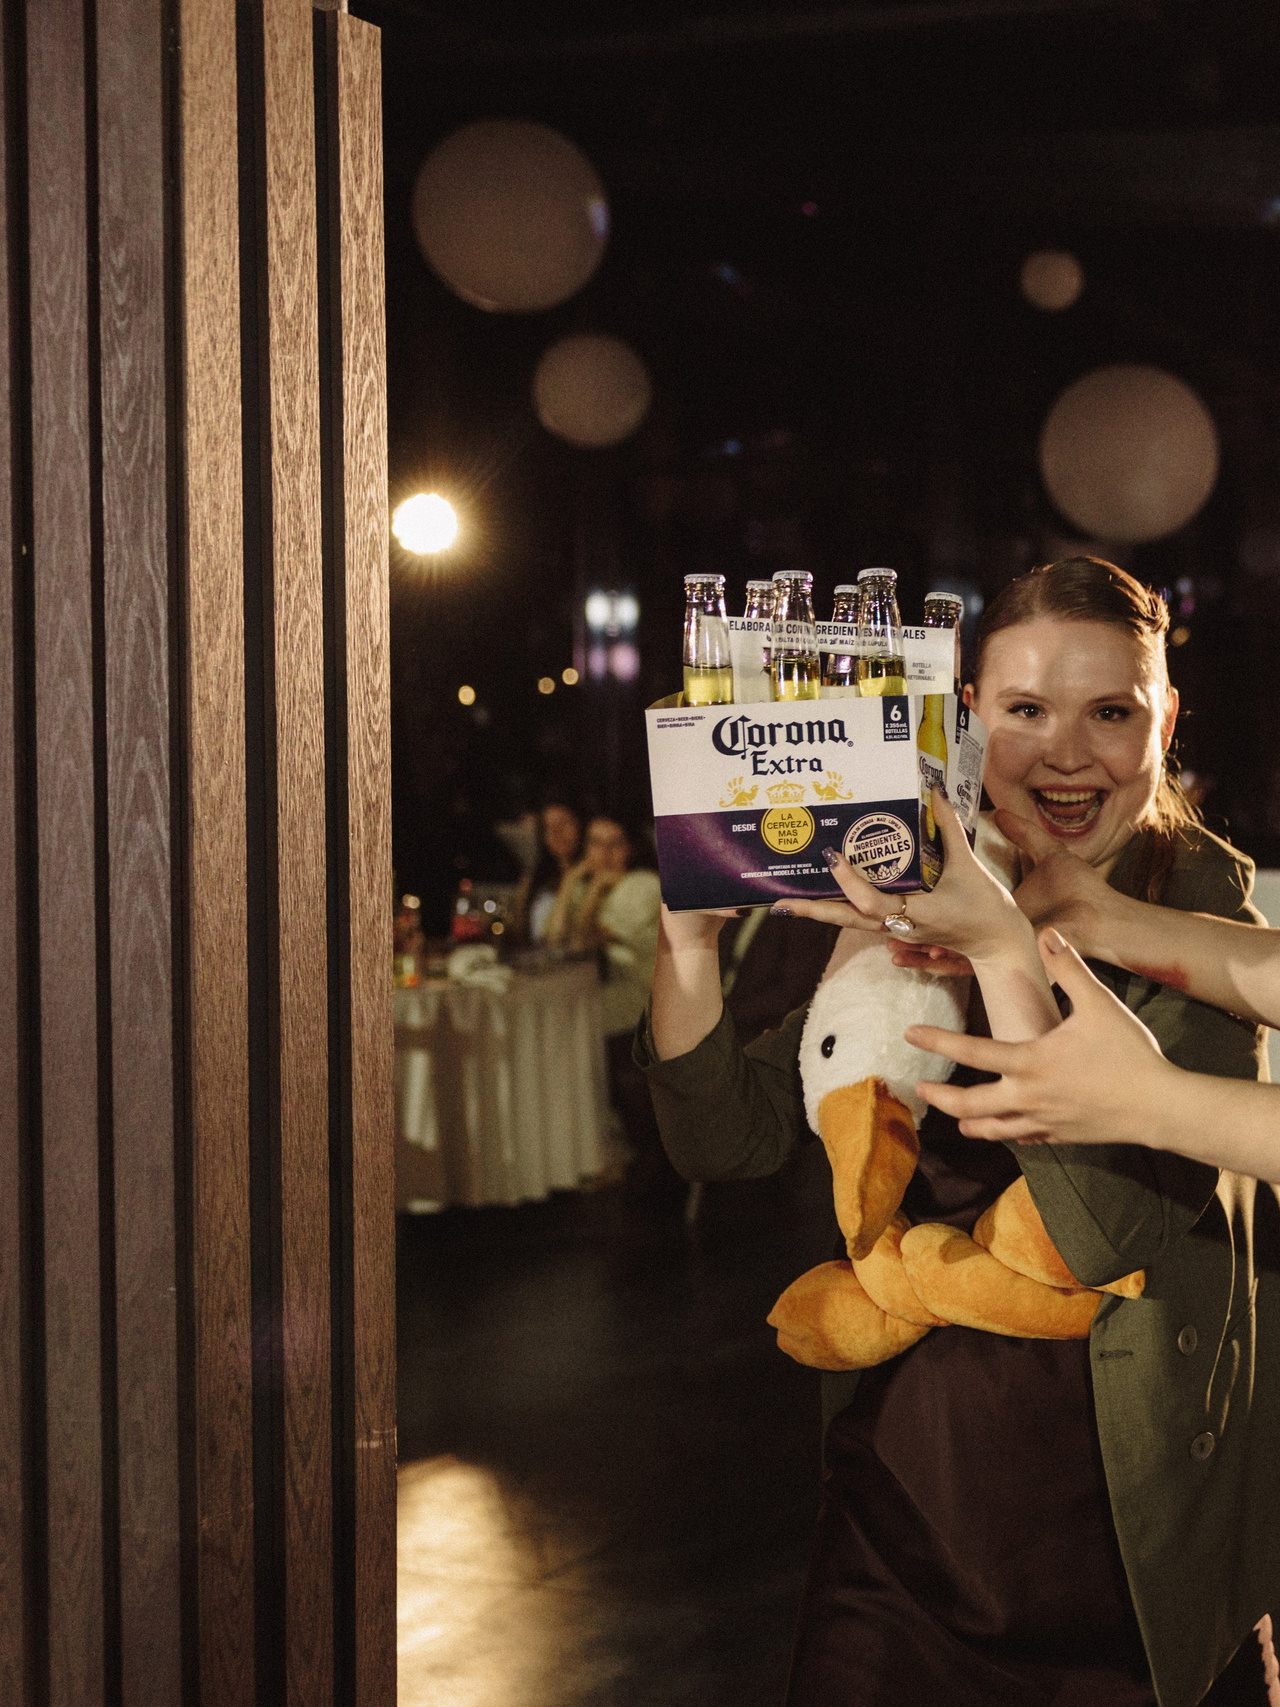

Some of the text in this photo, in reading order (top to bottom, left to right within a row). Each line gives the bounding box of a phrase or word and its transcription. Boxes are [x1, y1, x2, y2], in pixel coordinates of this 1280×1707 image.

[890, 704, 902, 722] 6
[960, 711, 966, 727] 6
[712, 715, 849, 760] Corona
[750, 750, 824, 776] Extra
[781, 813, 794, 821] LA
[820, 818, 838, 827] 1925
[732, 823, 757, 832] DESDE
[766, 820, 809, 830] CERVEZA
[778, 837, 799, 845] FINA
[853, 832, 902, 852] INGREDIENTES
[849, 839, 911, 866] NATURALES
[741, 871, 773, 879] CERVECERIA
